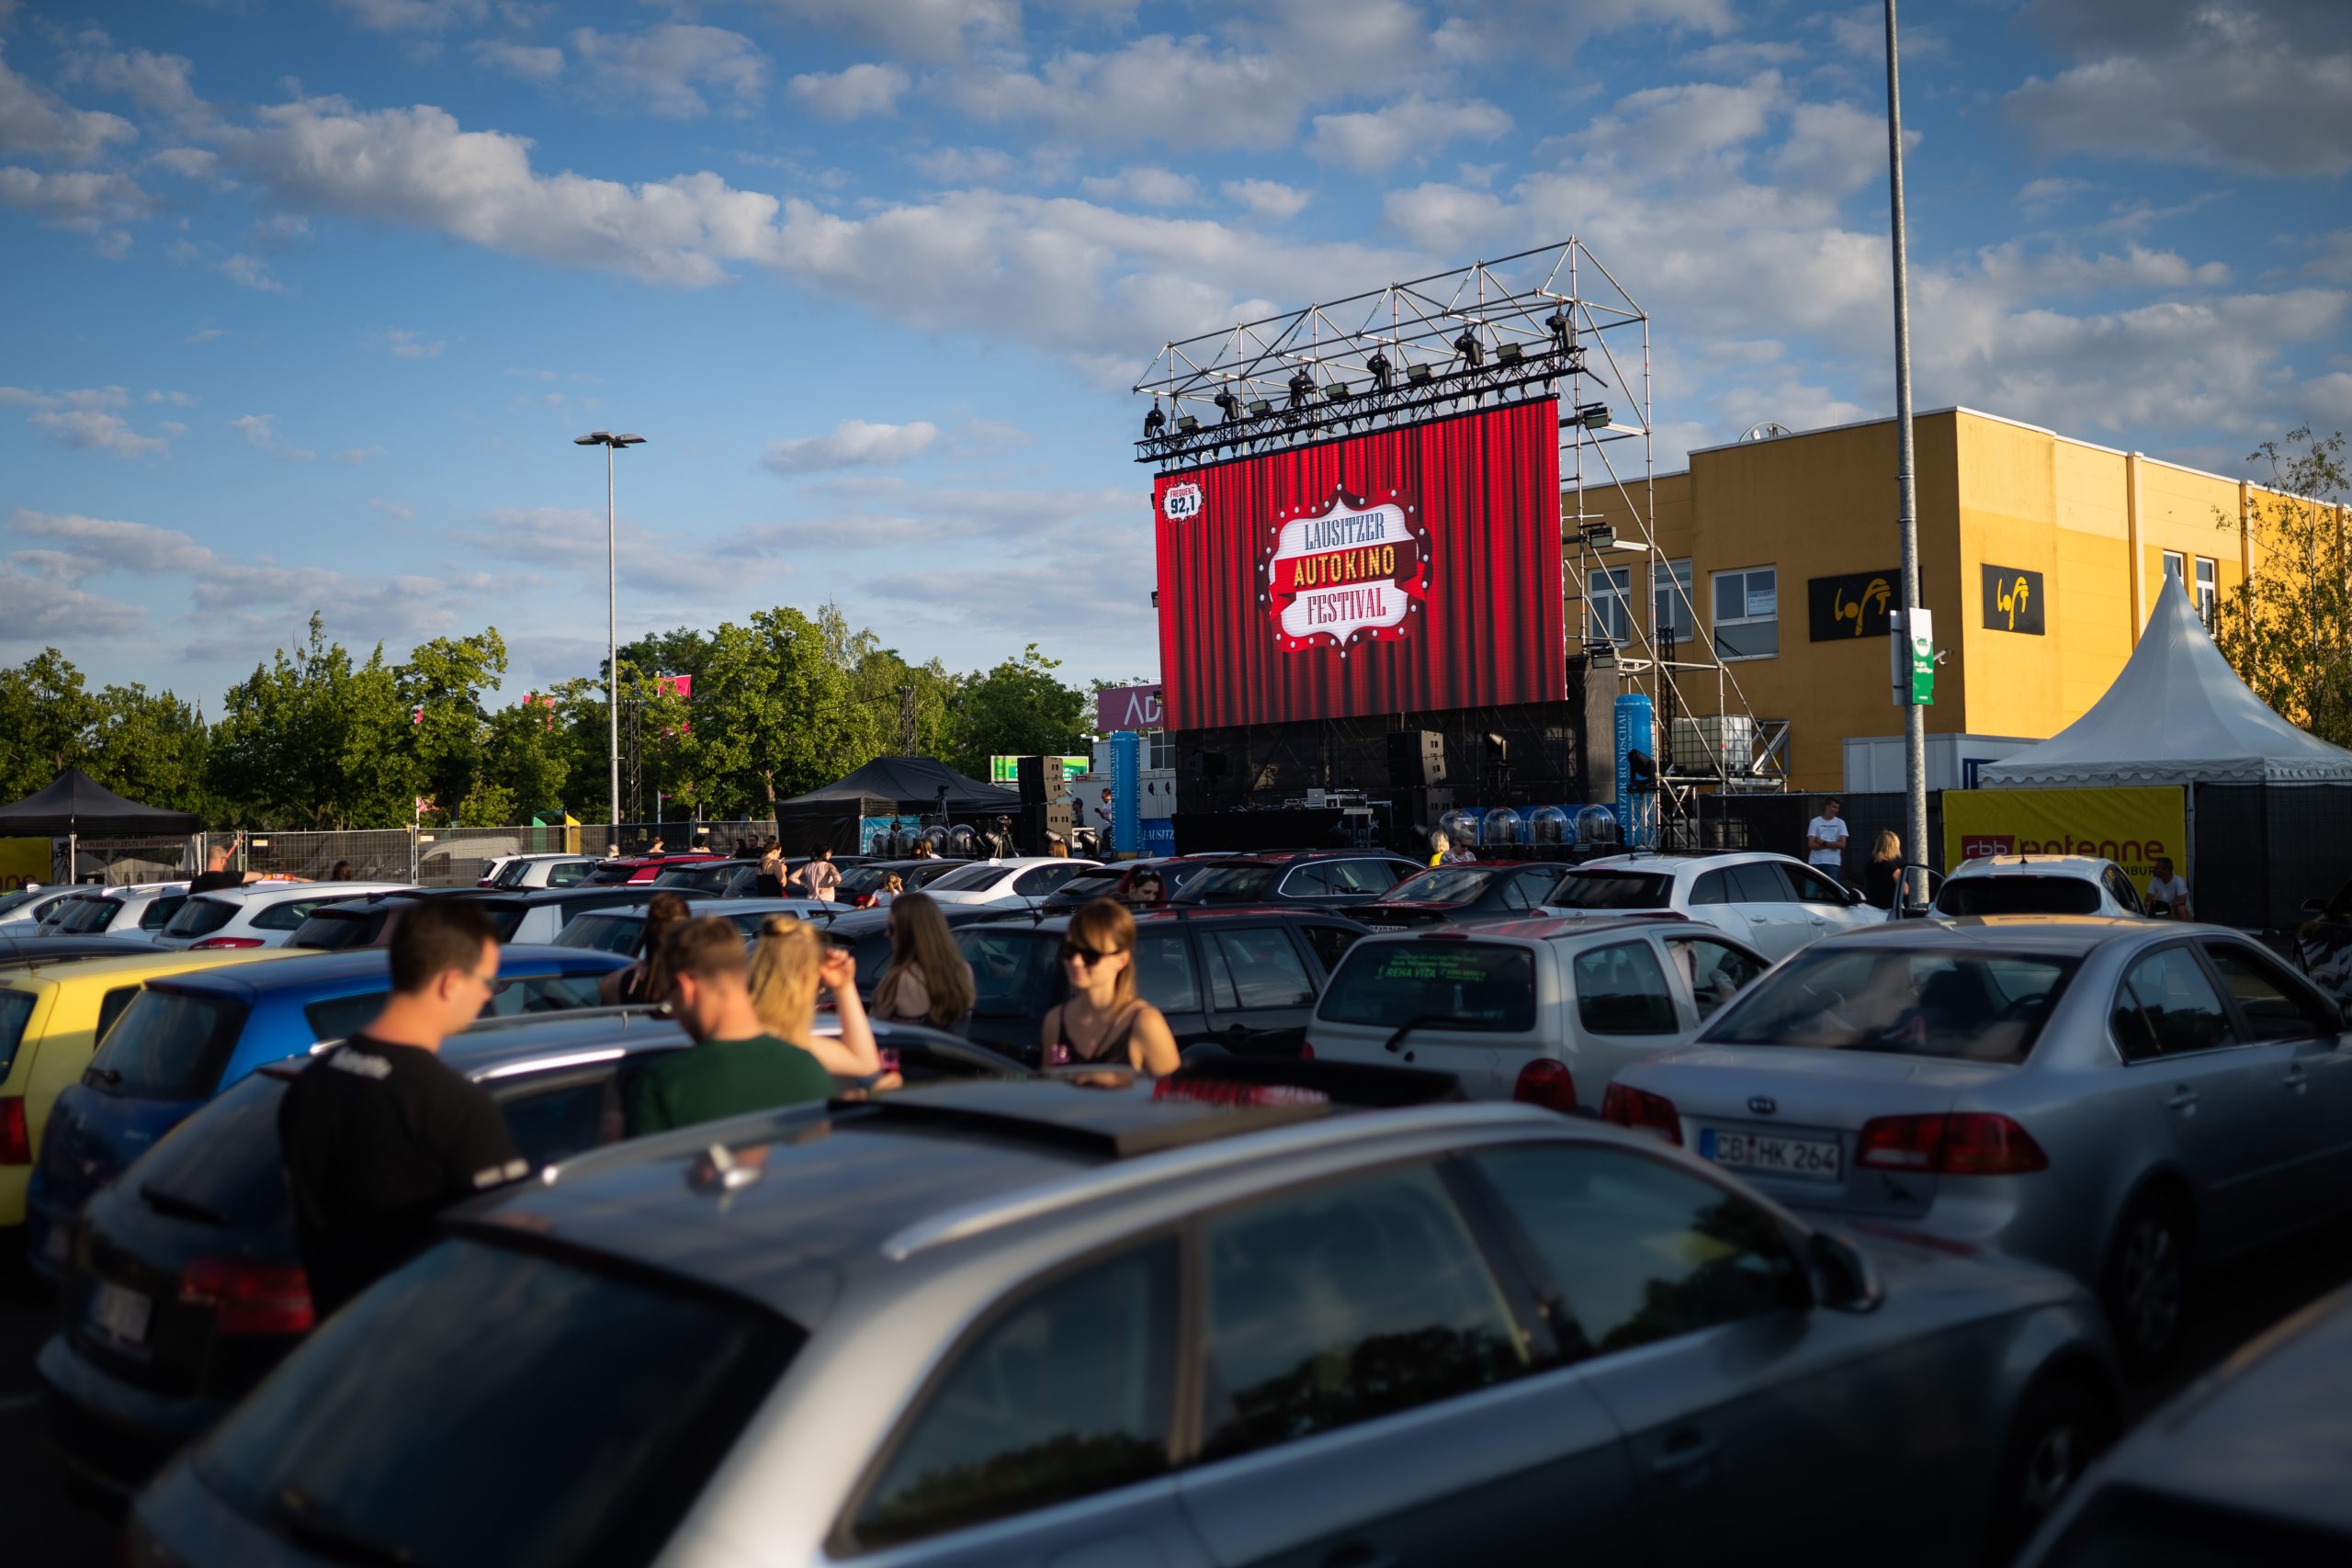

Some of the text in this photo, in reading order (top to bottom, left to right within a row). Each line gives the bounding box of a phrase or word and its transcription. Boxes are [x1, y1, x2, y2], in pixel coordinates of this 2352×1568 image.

[1170, 487, 1194, 498] FREQUENZ
[1170, 495, 1194, 514] 92,1
[1305, 513, 1385, 550] LAUSITZER
[1294, 545, 1395, 587] AUTOKINO
[1307, 587, 1387, 625] FESTIVAL
[1124, 691, 1164, 726] AD
[1618, 710, 1628, 778] RUNDSCHAU
[1142, 829, 1175, 840] LAUSITZ
[1966, 840, 2007, 855] rbb
[1385, 968, 1411, 977] REHA
[1415, 968, 1436, 977] VITA
[1716, 1135, 1836, 1170] CB HK 264
